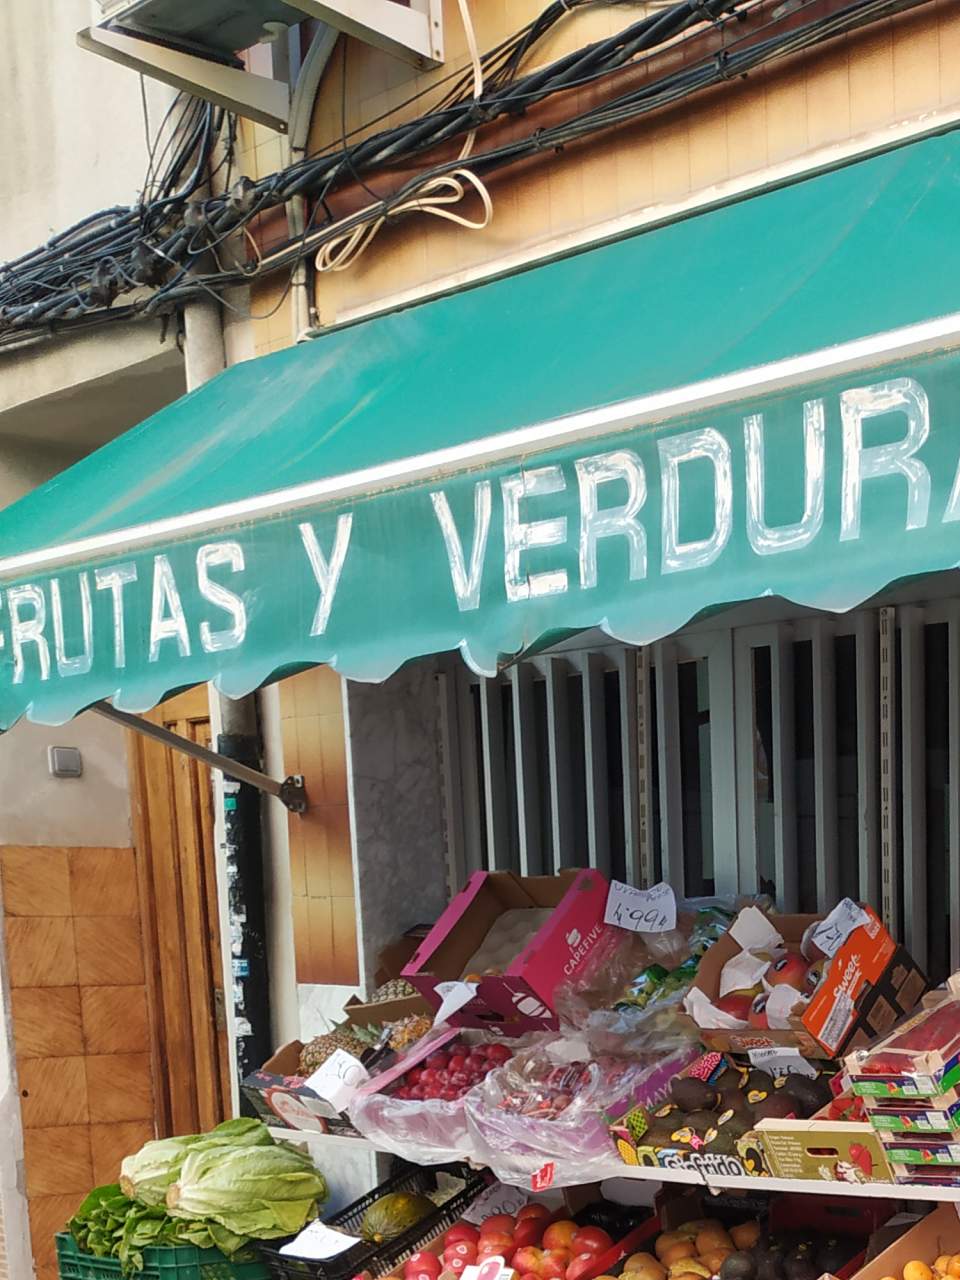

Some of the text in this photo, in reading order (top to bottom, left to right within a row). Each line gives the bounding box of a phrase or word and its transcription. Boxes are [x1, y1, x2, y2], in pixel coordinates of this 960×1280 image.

[0, 542, 247, 684] RUTAS
[301, 512, 354, 636] Y
[563, 923, 604, 976] CAPEFIVE
